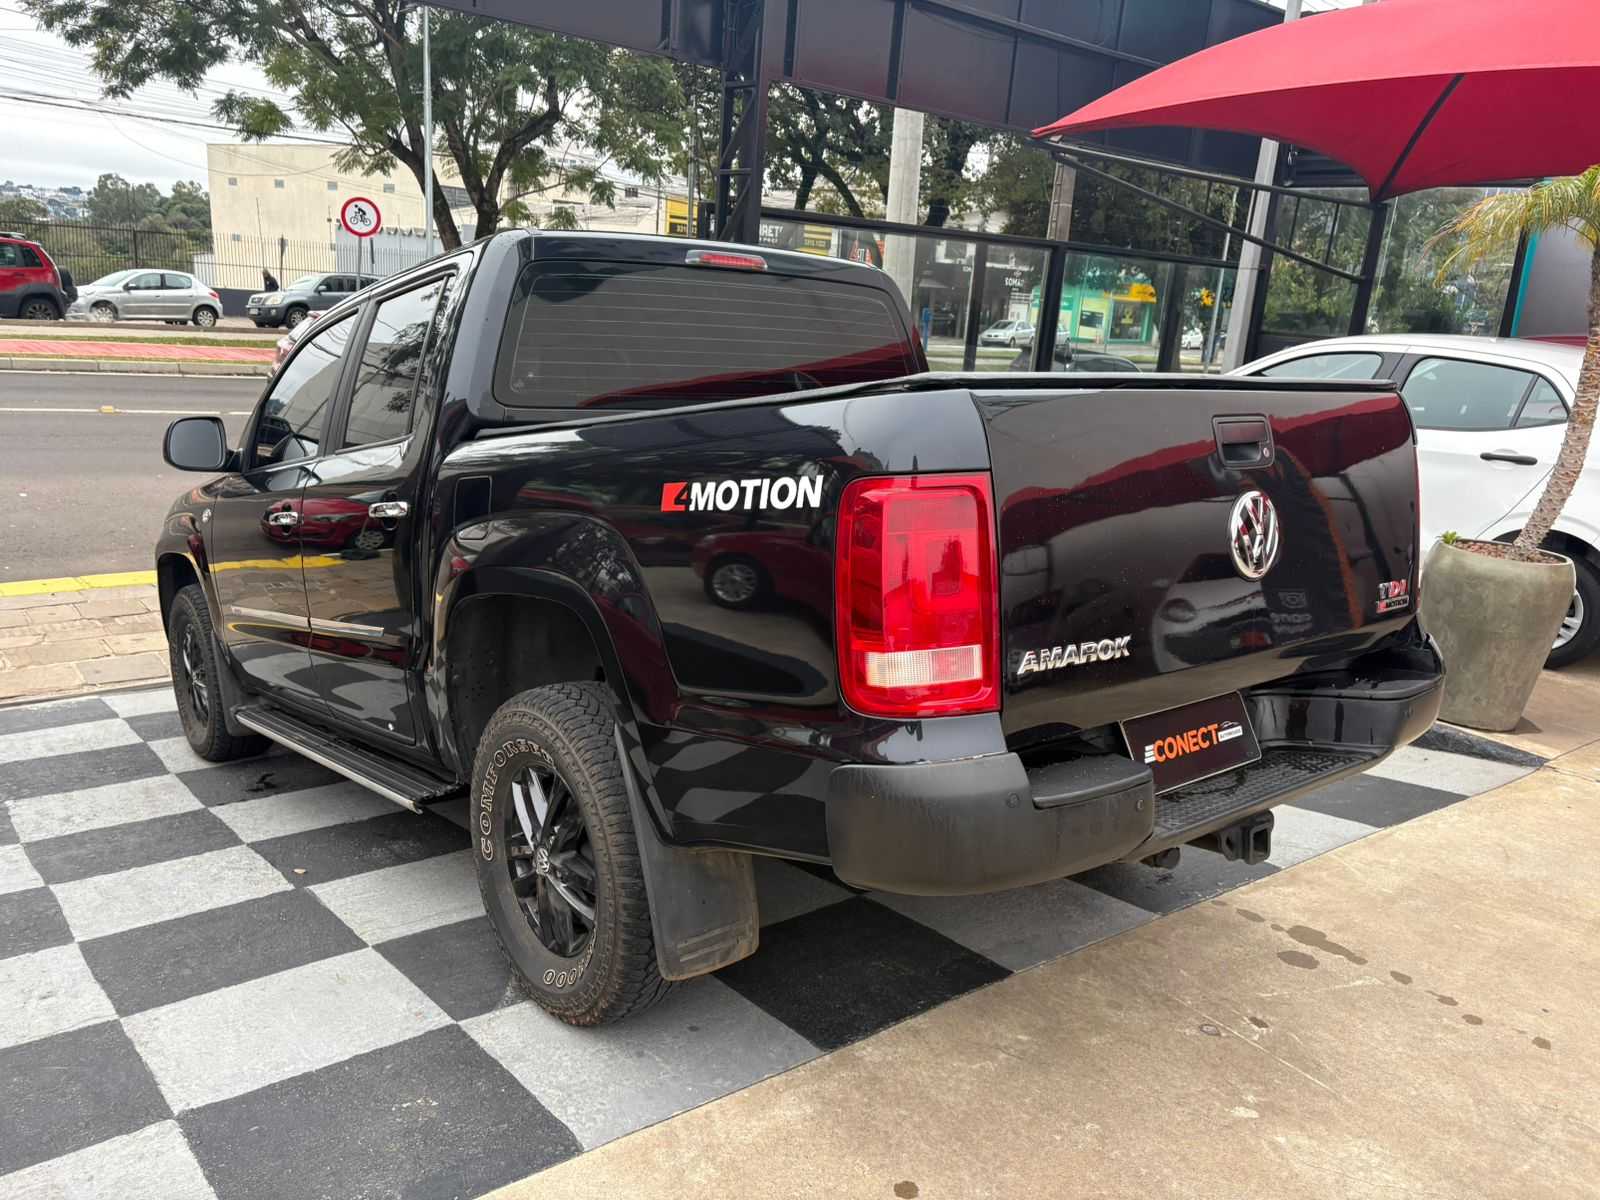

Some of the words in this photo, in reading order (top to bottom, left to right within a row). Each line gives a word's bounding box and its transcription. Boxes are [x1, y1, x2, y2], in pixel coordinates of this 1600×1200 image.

[661, 475, 824, 512] 4MOTION
[1016, 634, 1132, 675] AMAROK
[1153, 723, 1219, 763] CONECT
